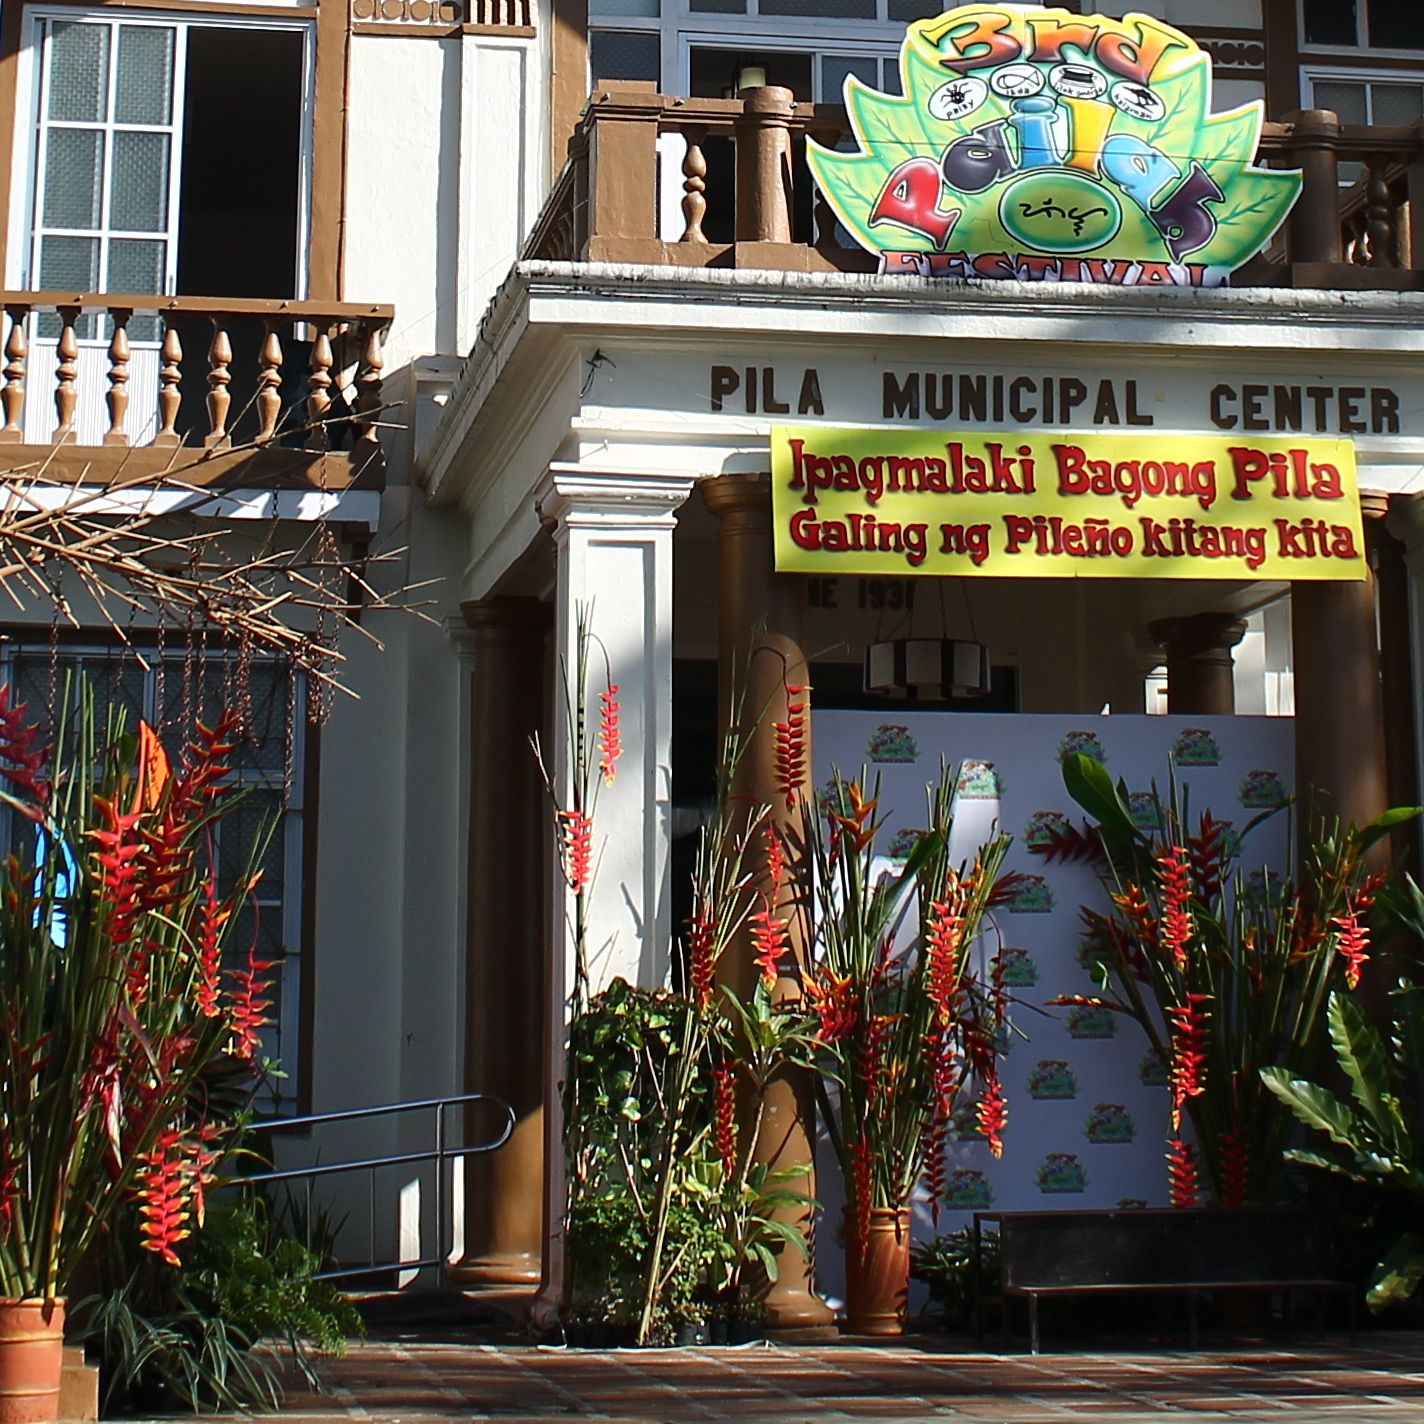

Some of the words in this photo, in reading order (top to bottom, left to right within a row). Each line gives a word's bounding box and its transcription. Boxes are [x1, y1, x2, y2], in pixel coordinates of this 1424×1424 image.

[920, 11, 1187, 84] 3rd
[946, 98, 974, 119] palay
[710, 365, 824, 416] PILA
[882, 372, 1154, 426] MUNICIPAL
[1209, 383, 1400, 433] CENTER
[788, 439, 1037, 506] Ipagmalaki
[1051, 444, 1218, 510] Bagong
[1228, 447, 1345, 500] Pila
[789, 507, 928, 566] Galing
[940, 523, 991, 566] ng
[1003, 515, 1133, 557] Pileño
